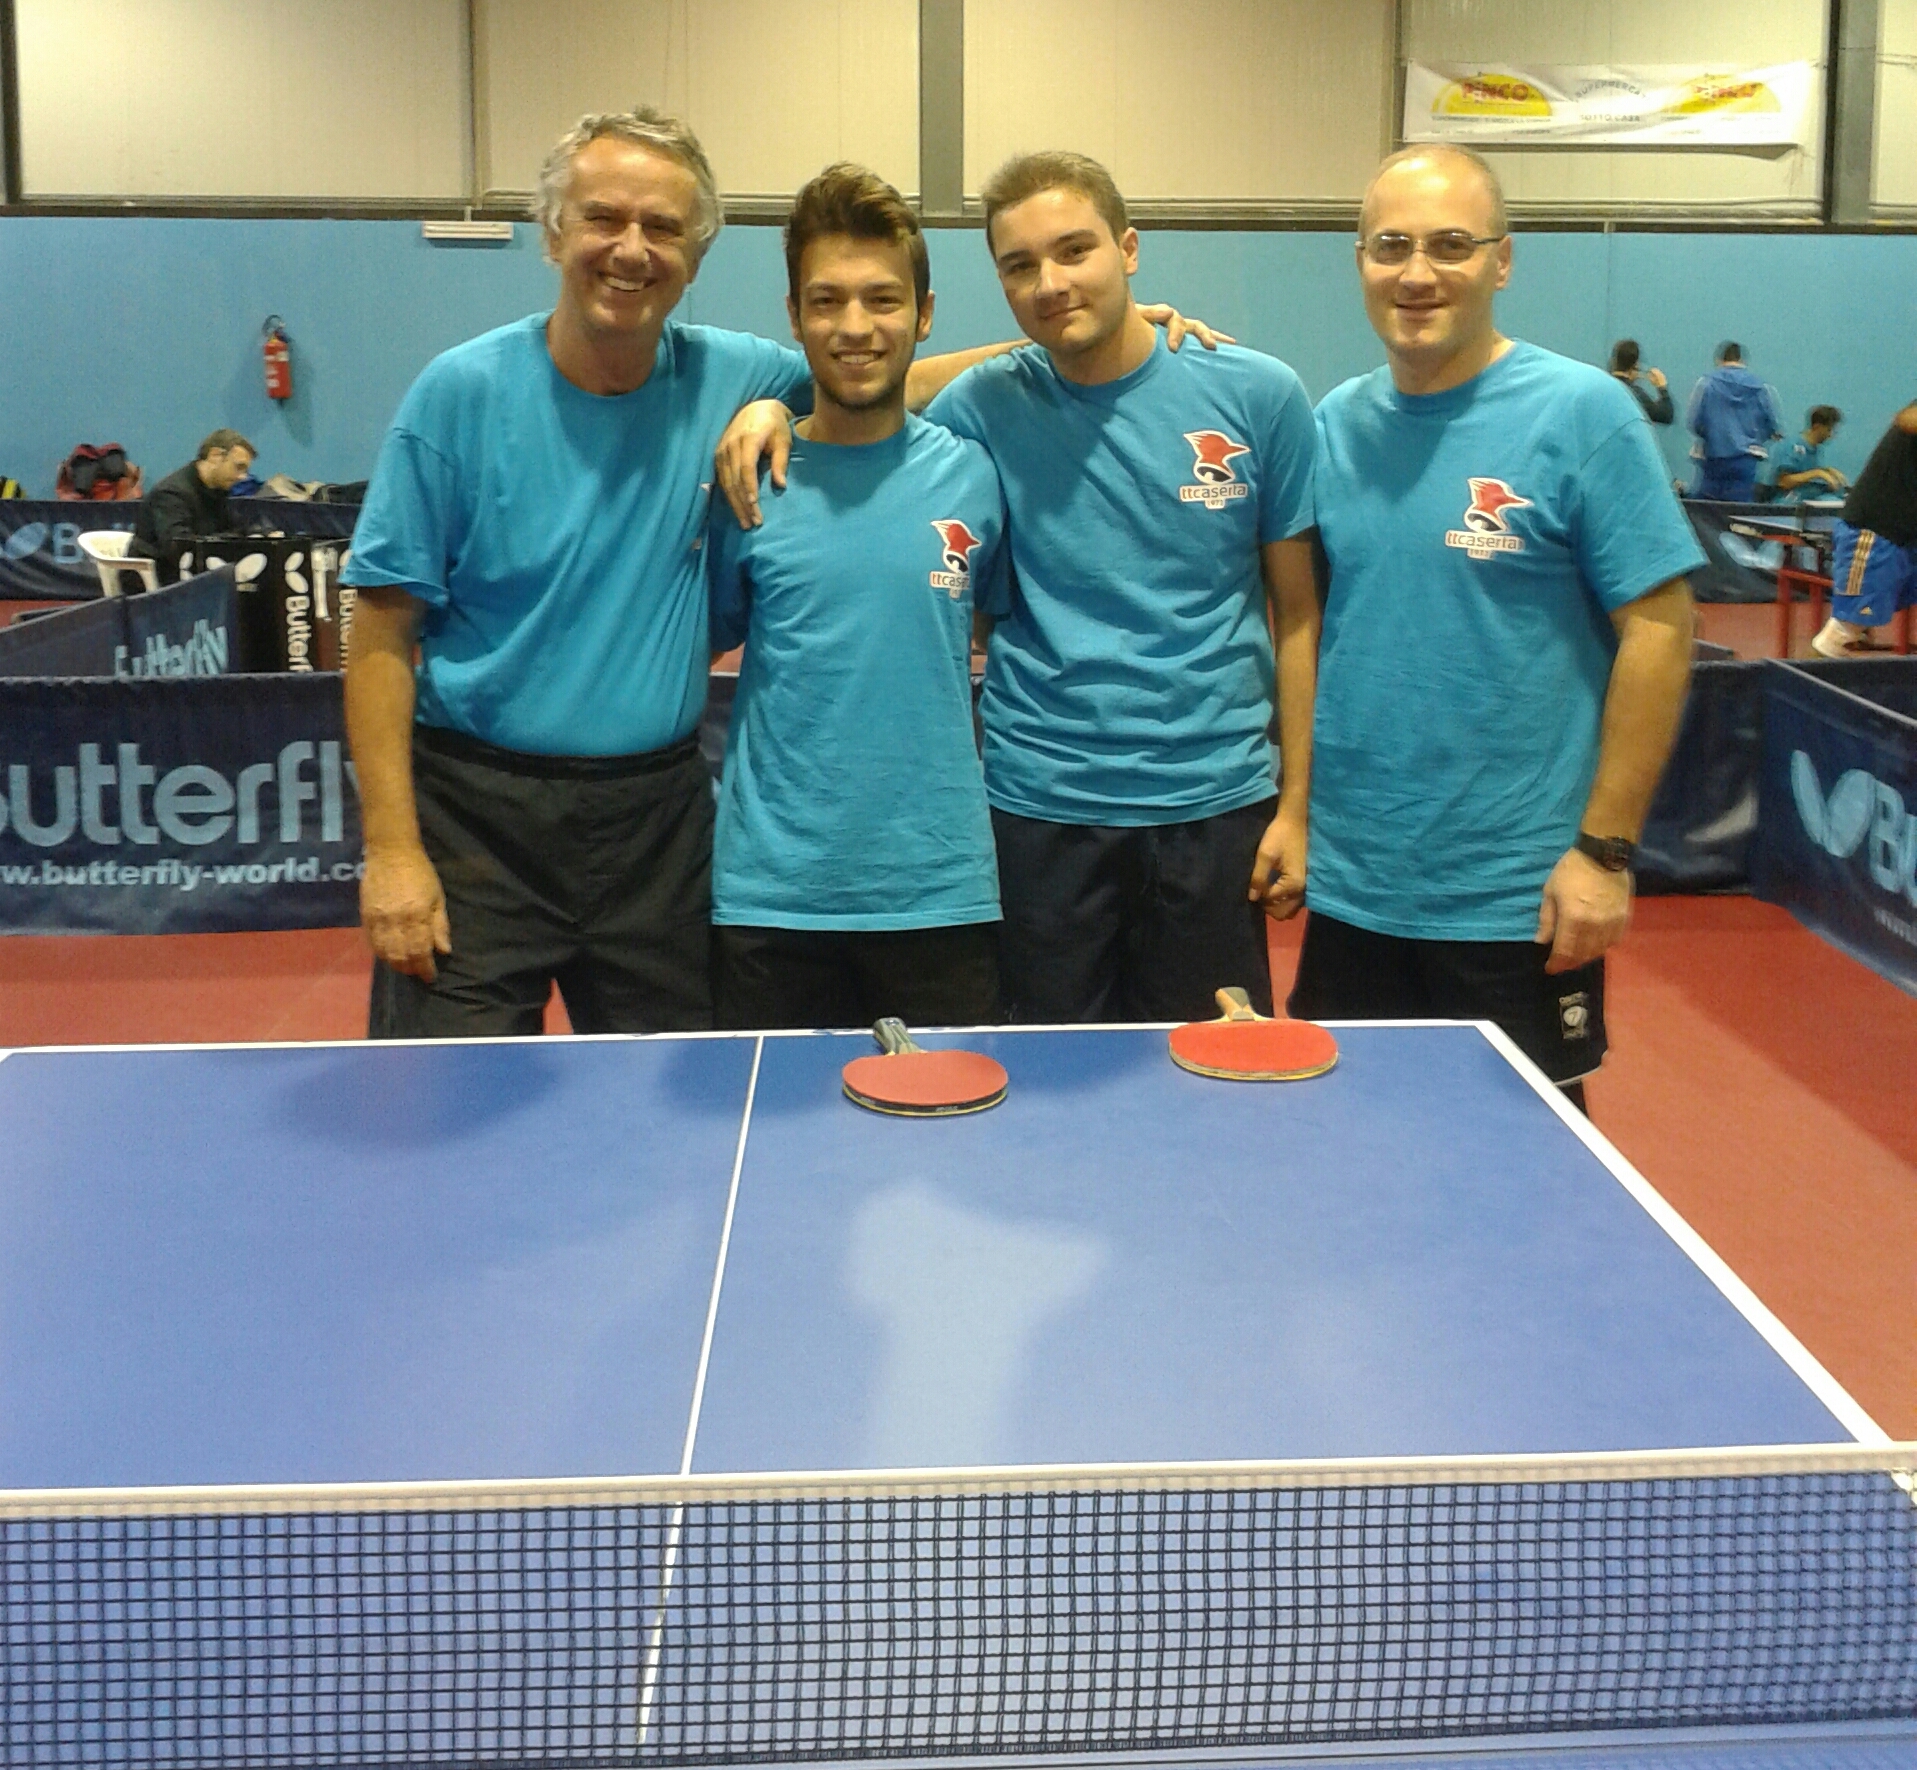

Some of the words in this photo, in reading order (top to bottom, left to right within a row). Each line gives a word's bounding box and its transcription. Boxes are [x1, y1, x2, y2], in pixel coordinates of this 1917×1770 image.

[1181, 484, 1247, 500] ttcaserta
[1447, 532, 1517, 550] ttcaserta
[0, 740, 362, 847] utterfl
